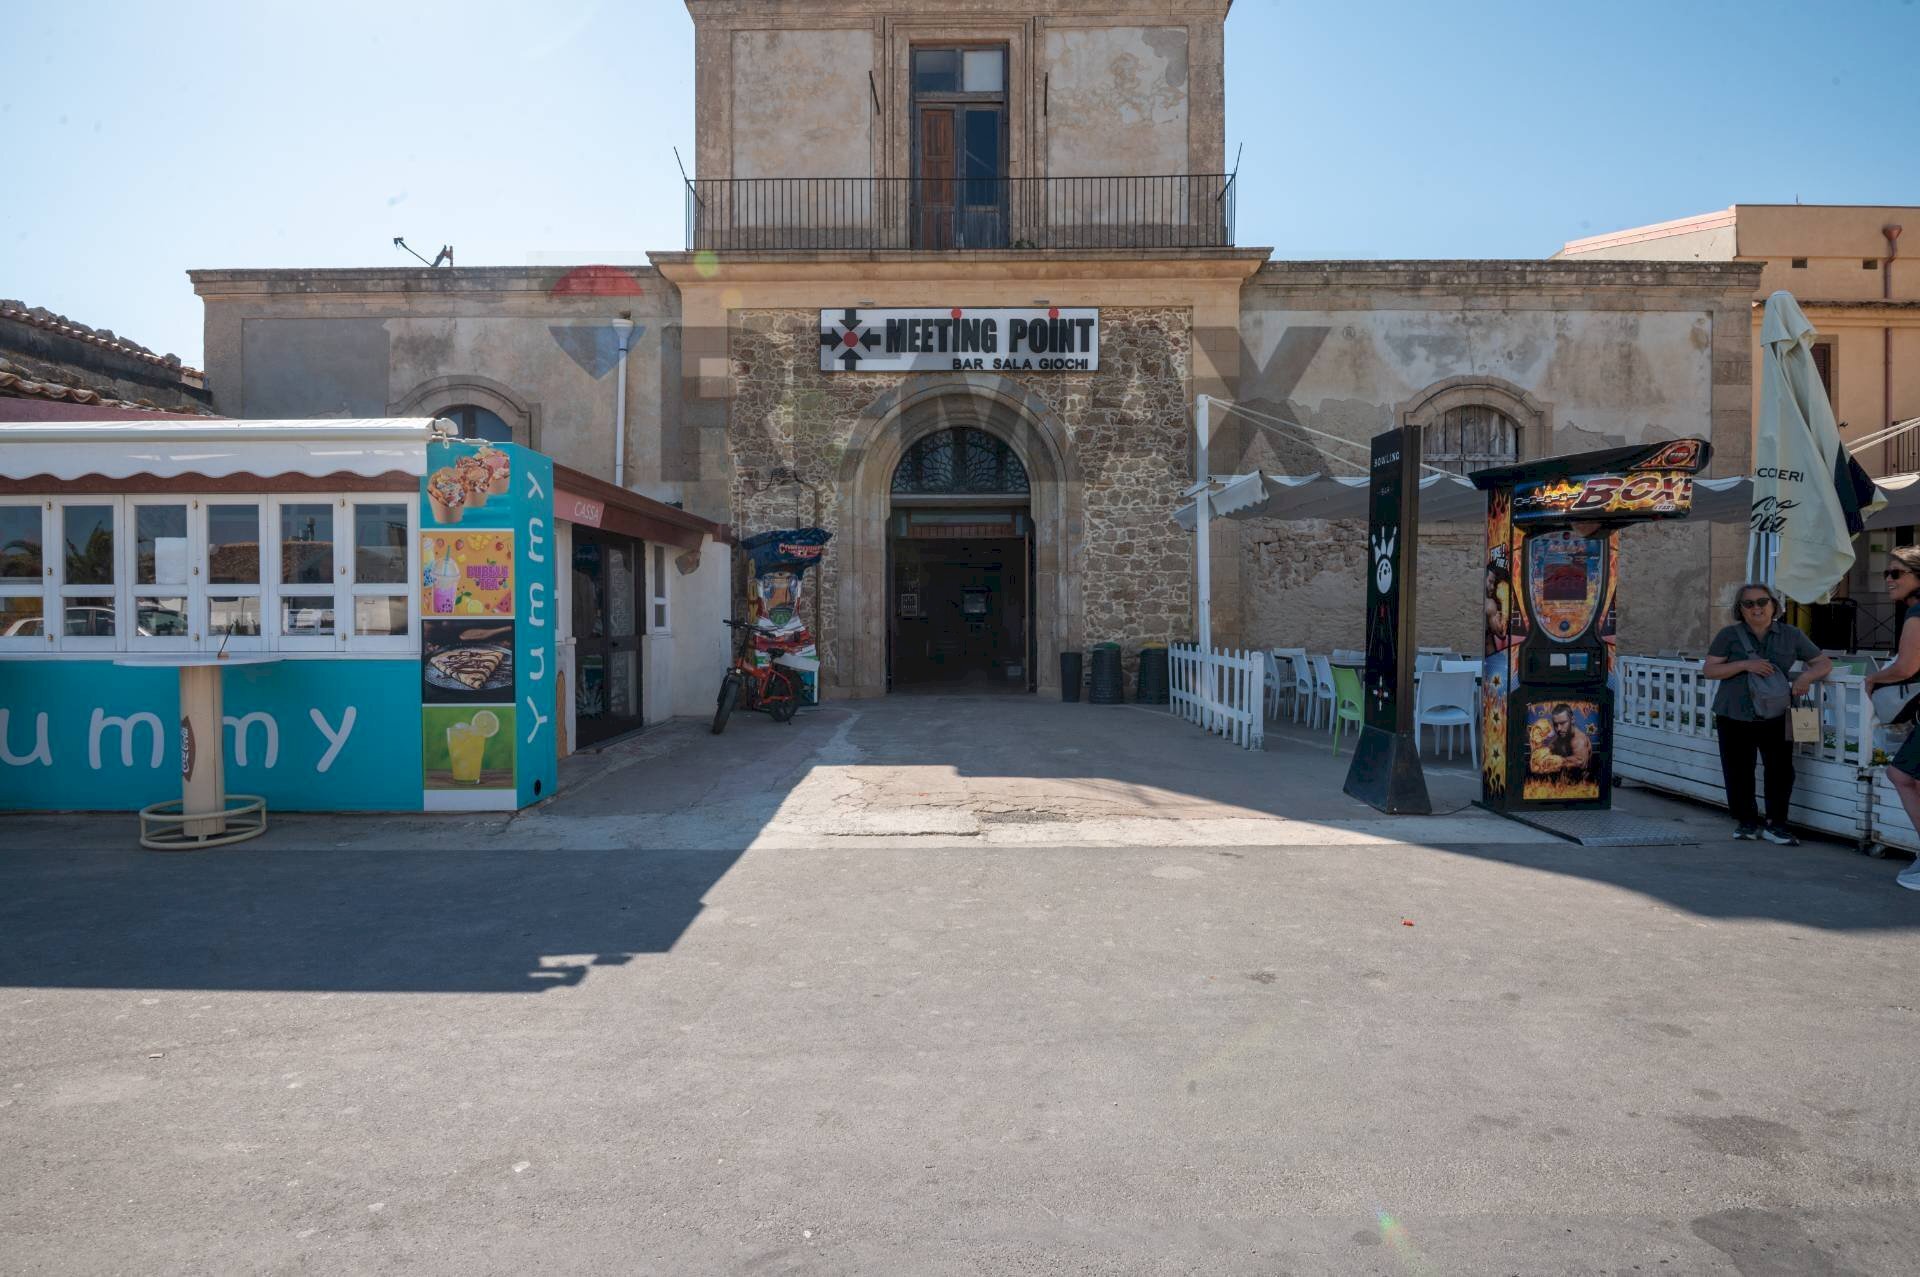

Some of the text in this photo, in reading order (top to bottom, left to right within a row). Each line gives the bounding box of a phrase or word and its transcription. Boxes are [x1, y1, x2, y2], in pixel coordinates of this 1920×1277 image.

[886, 309, 1095, 353] MEETING POINT
[952, 358, 1089, 370] BAR SALA GIOCHI
[574, 501, 600, 521] CASSA
[526, 471, 548, 743] Yummy
